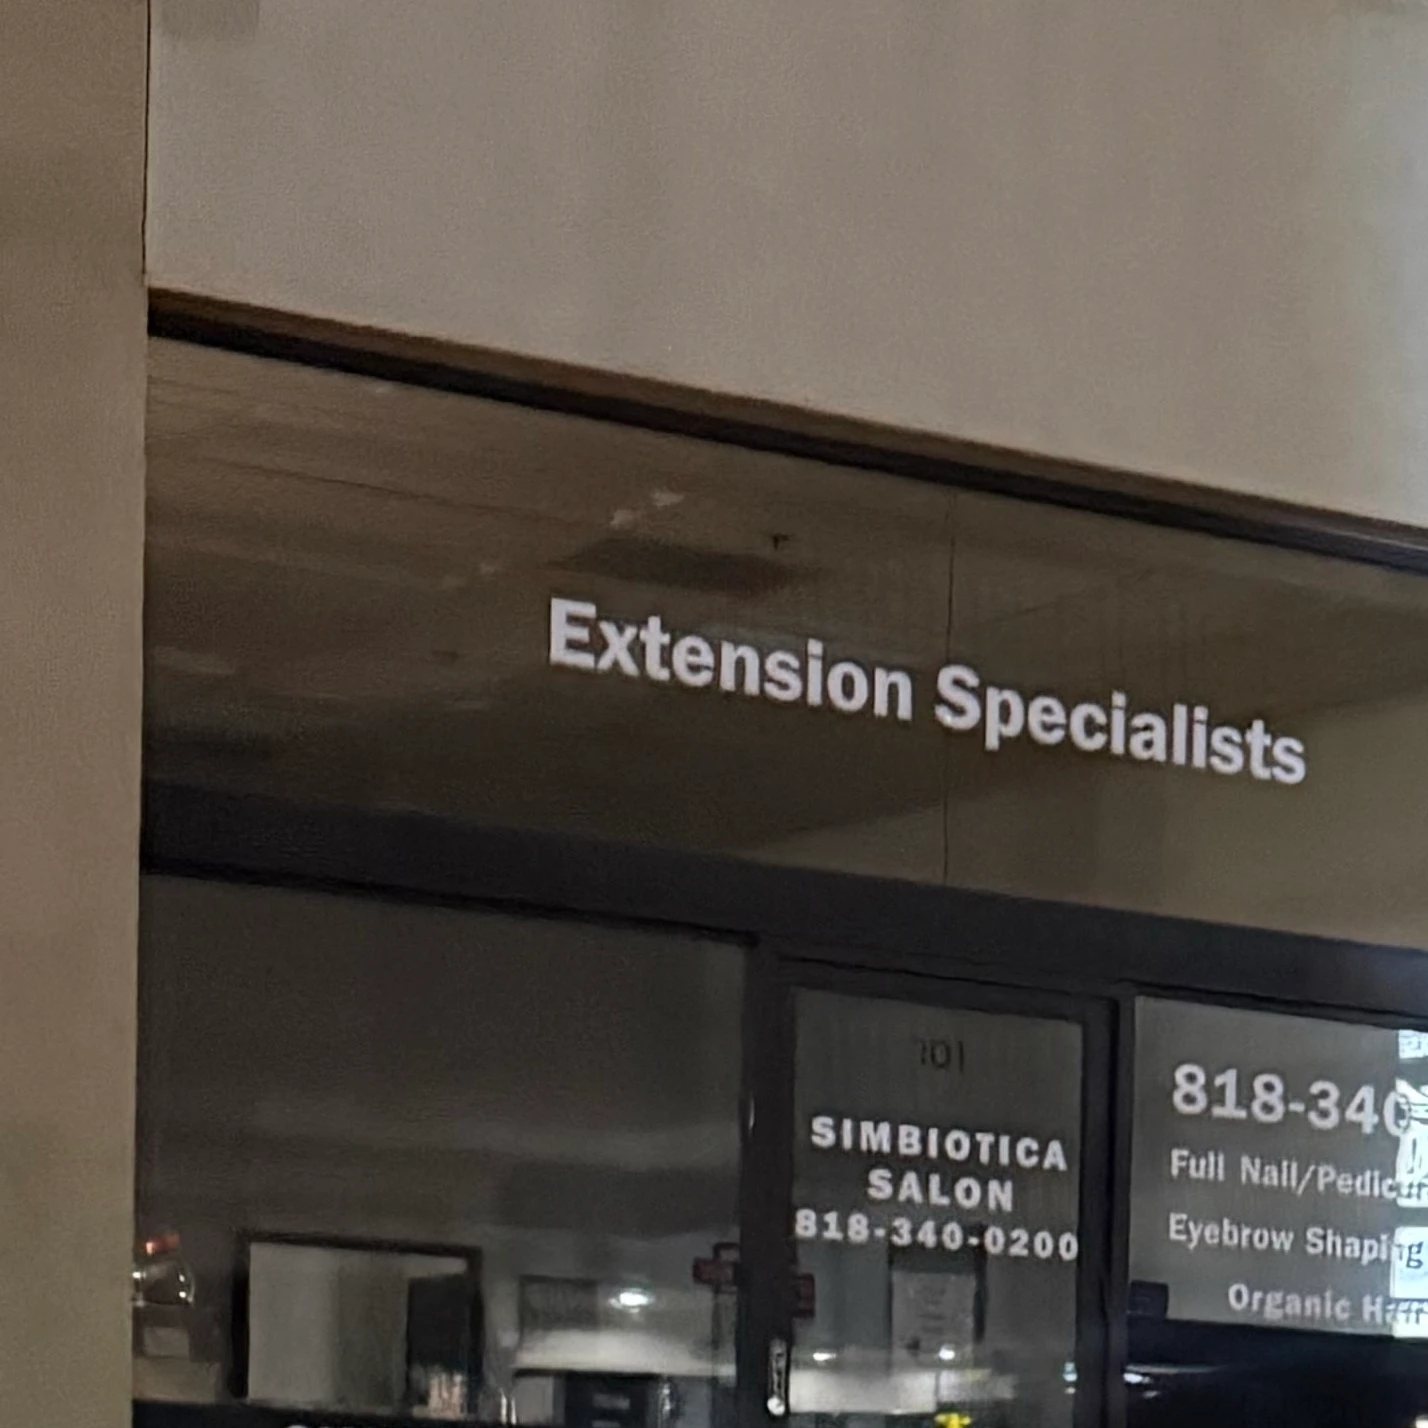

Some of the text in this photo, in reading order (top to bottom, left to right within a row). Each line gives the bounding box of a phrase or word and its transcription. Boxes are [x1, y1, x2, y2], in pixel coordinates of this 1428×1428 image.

[549, 598, 1306, 786] Extension Specialists
[917, 1039, 965, 1073] 101
[811, 1116, 1067, 1171] SIMBIOTICA
[1171, 1148, 1225, 1182] Full
[867, 1169, 1013, 1212] SALON
[795, 1209, 1078, 1260] 818-340-0200
[1169, 1212, 1294, 1249] Eyebrow
[1228, 1283, 1350, 1321] Organic
